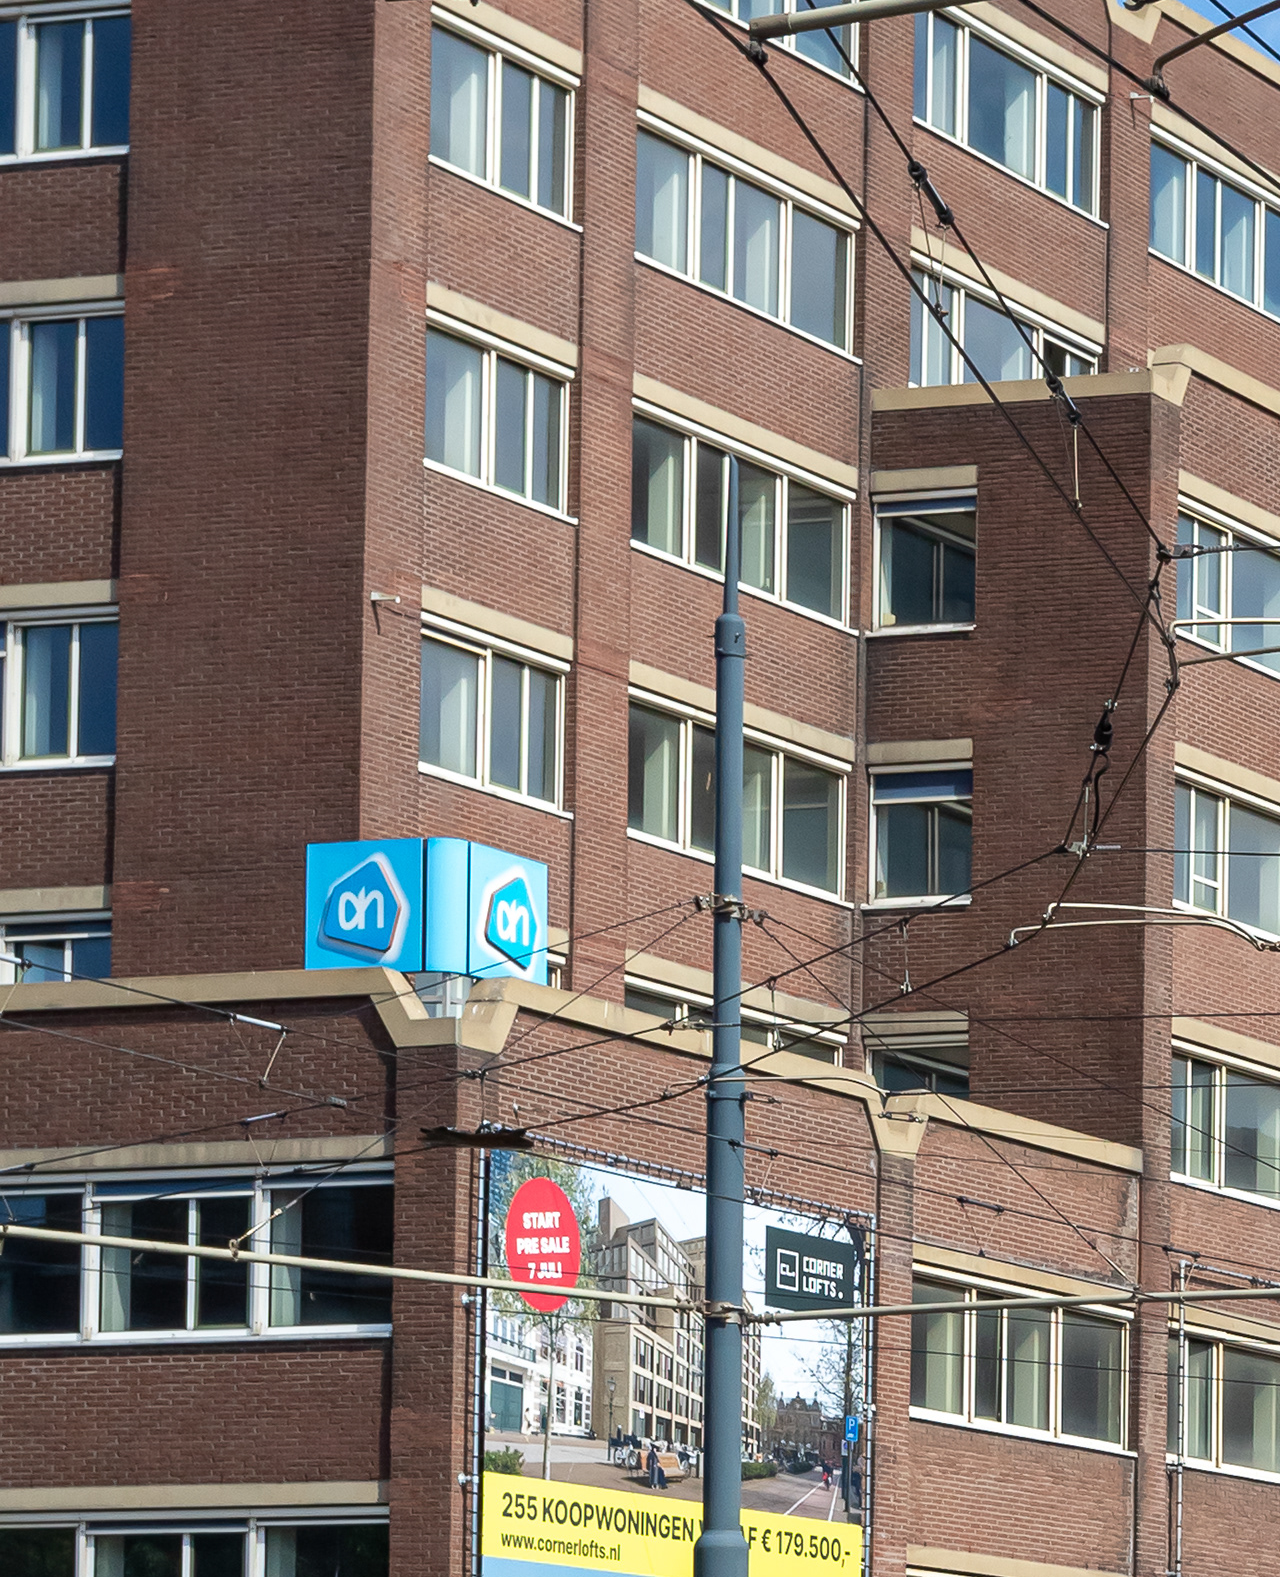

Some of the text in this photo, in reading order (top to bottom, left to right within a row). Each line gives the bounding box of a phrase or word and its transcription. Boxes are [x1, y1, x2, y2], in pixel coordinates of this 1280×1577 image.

[522, 1211, 561, 1230] START
[516, 1236, 570, 1255] PRE SALE
[528, 1262, 536, 1280] 7
[802, 1255, 844, 1280] CORNER
[501, 1492, 538, 1521] 255
[542, 1497, 695, 1543] KOOPWONINGEN
[761, 1528, 772, 1553] €
[775, 1531, 852, 1568] 179.500,-
[501, 1533, 622, 1561] www.cornerlofts.nl
